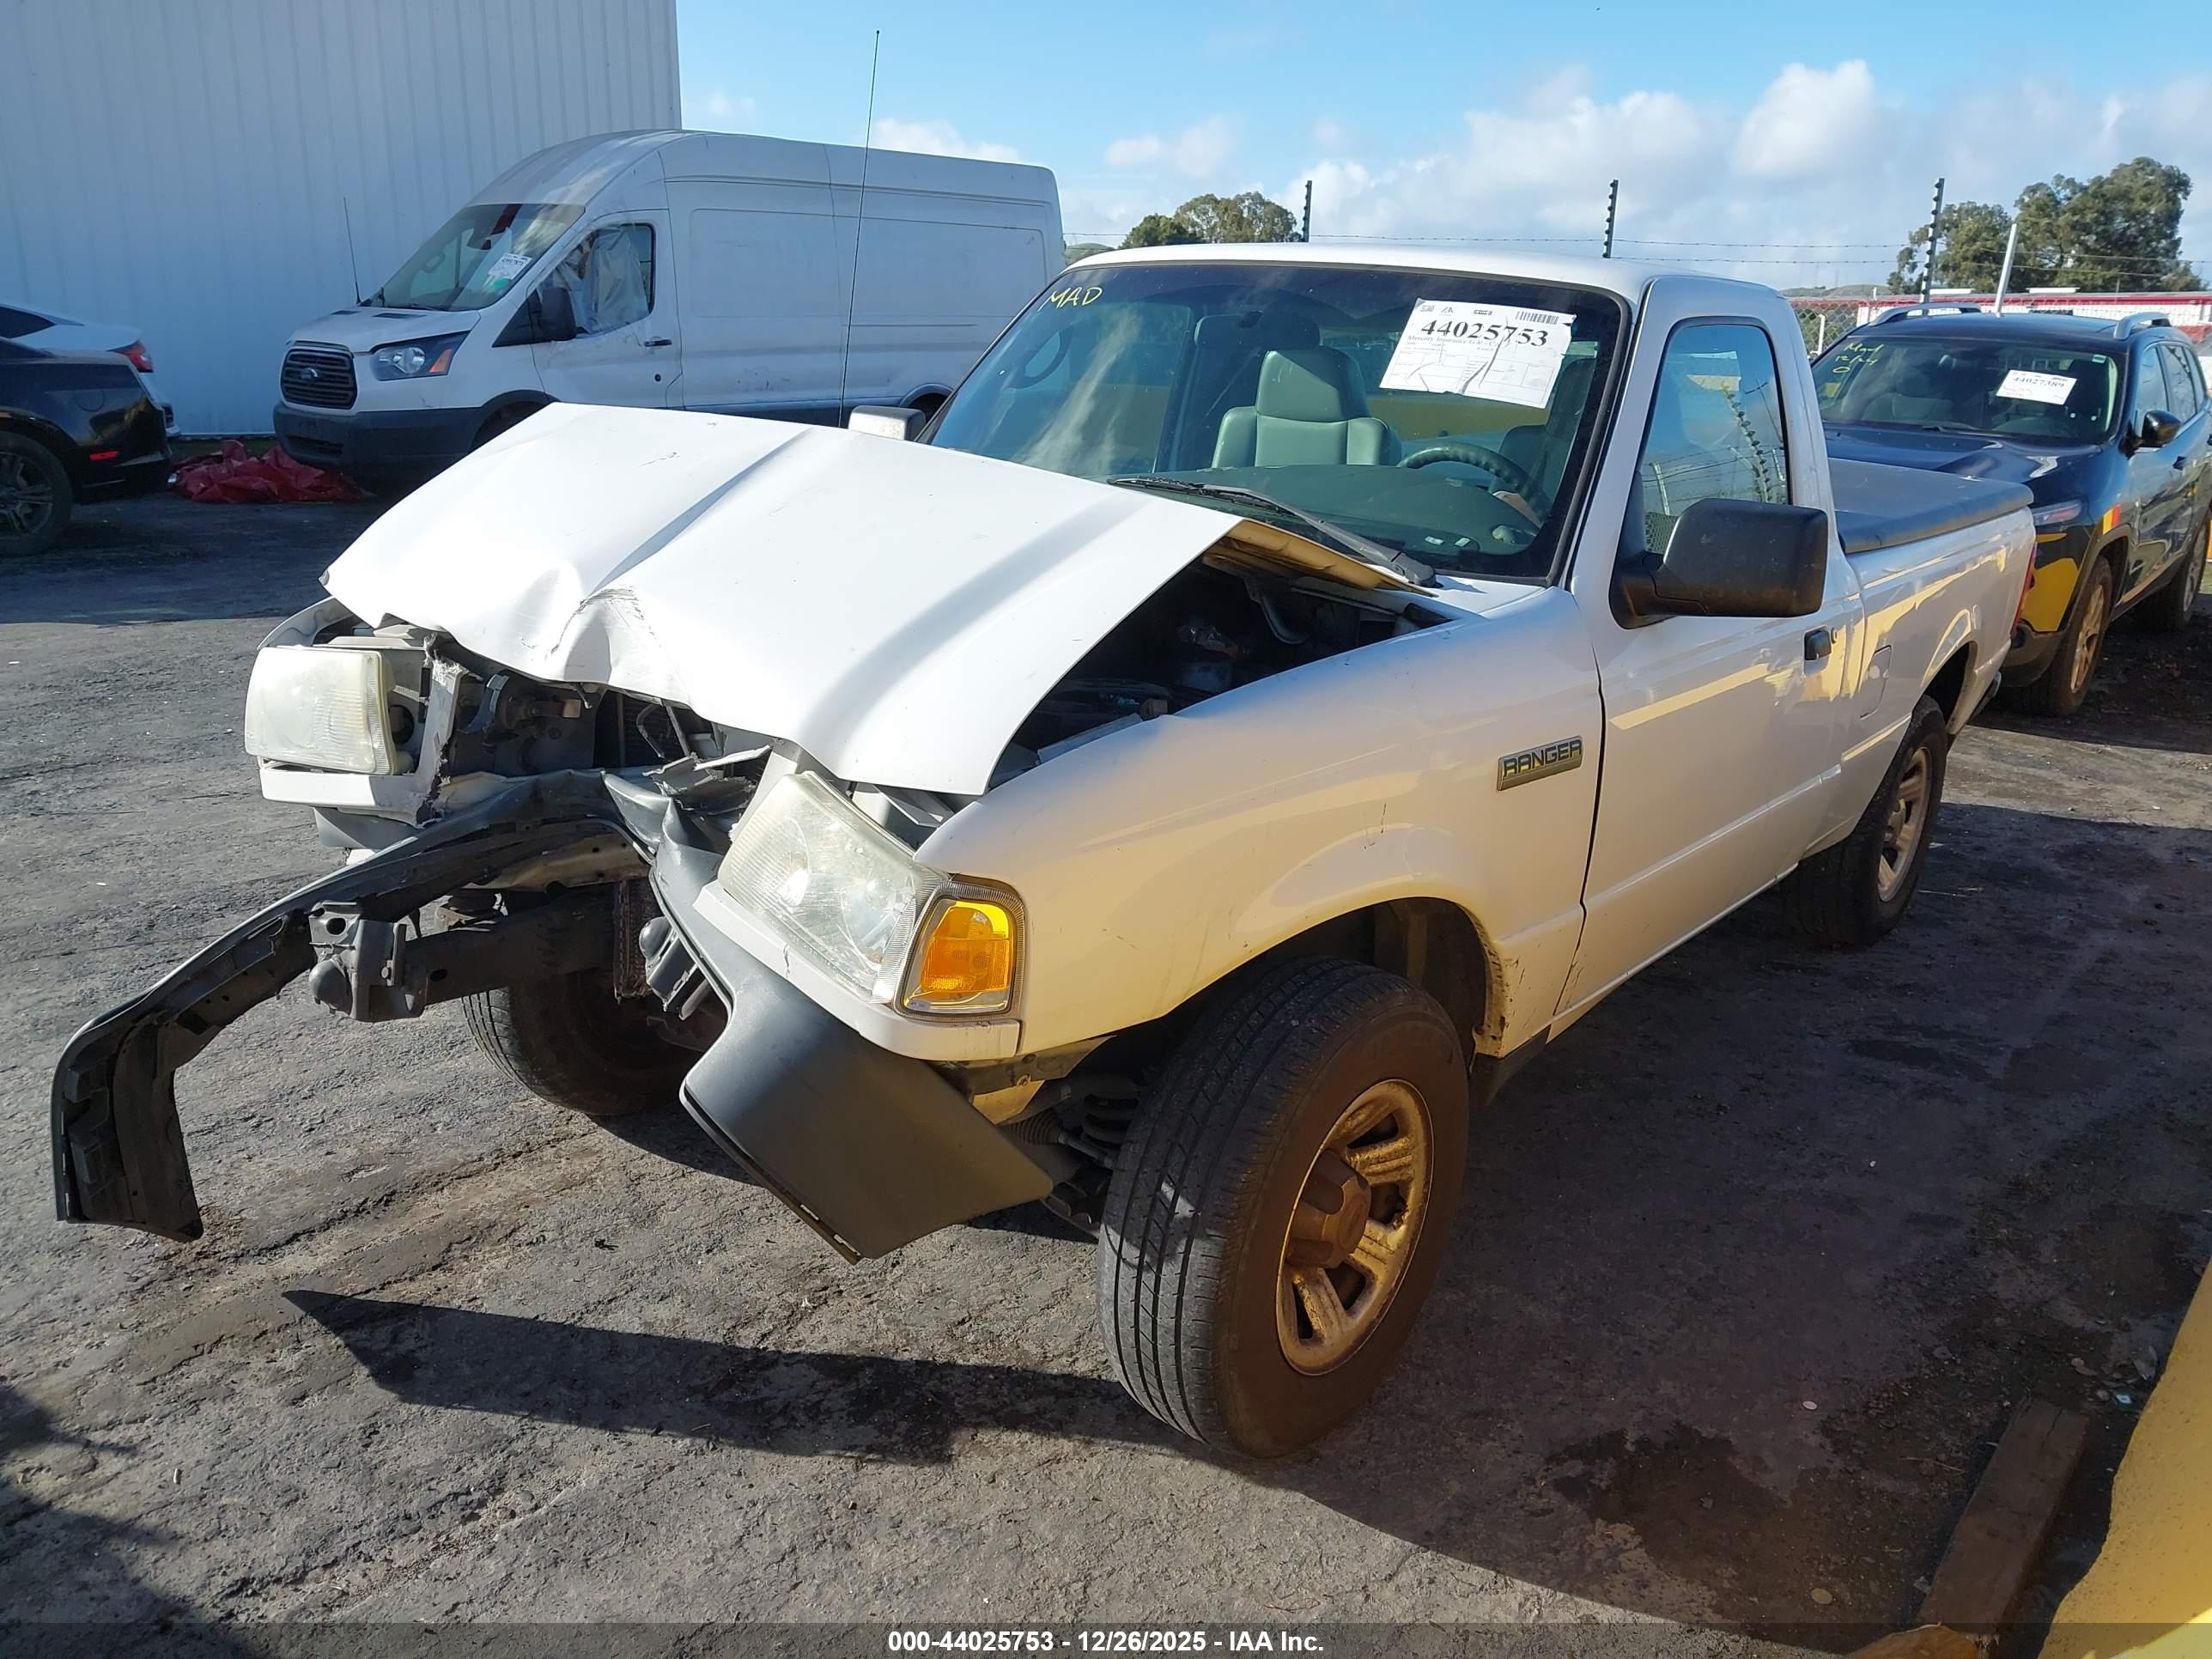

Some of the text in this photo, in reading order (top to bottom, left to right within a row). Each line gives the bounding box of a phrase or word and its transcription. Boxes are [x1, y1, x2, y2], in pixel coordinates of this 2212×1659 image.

[1037, 287, 1103, 312] MAD
[1421, 320, 1549, 347] 44025753
[1504, 739, 1582, 777] RANGER
